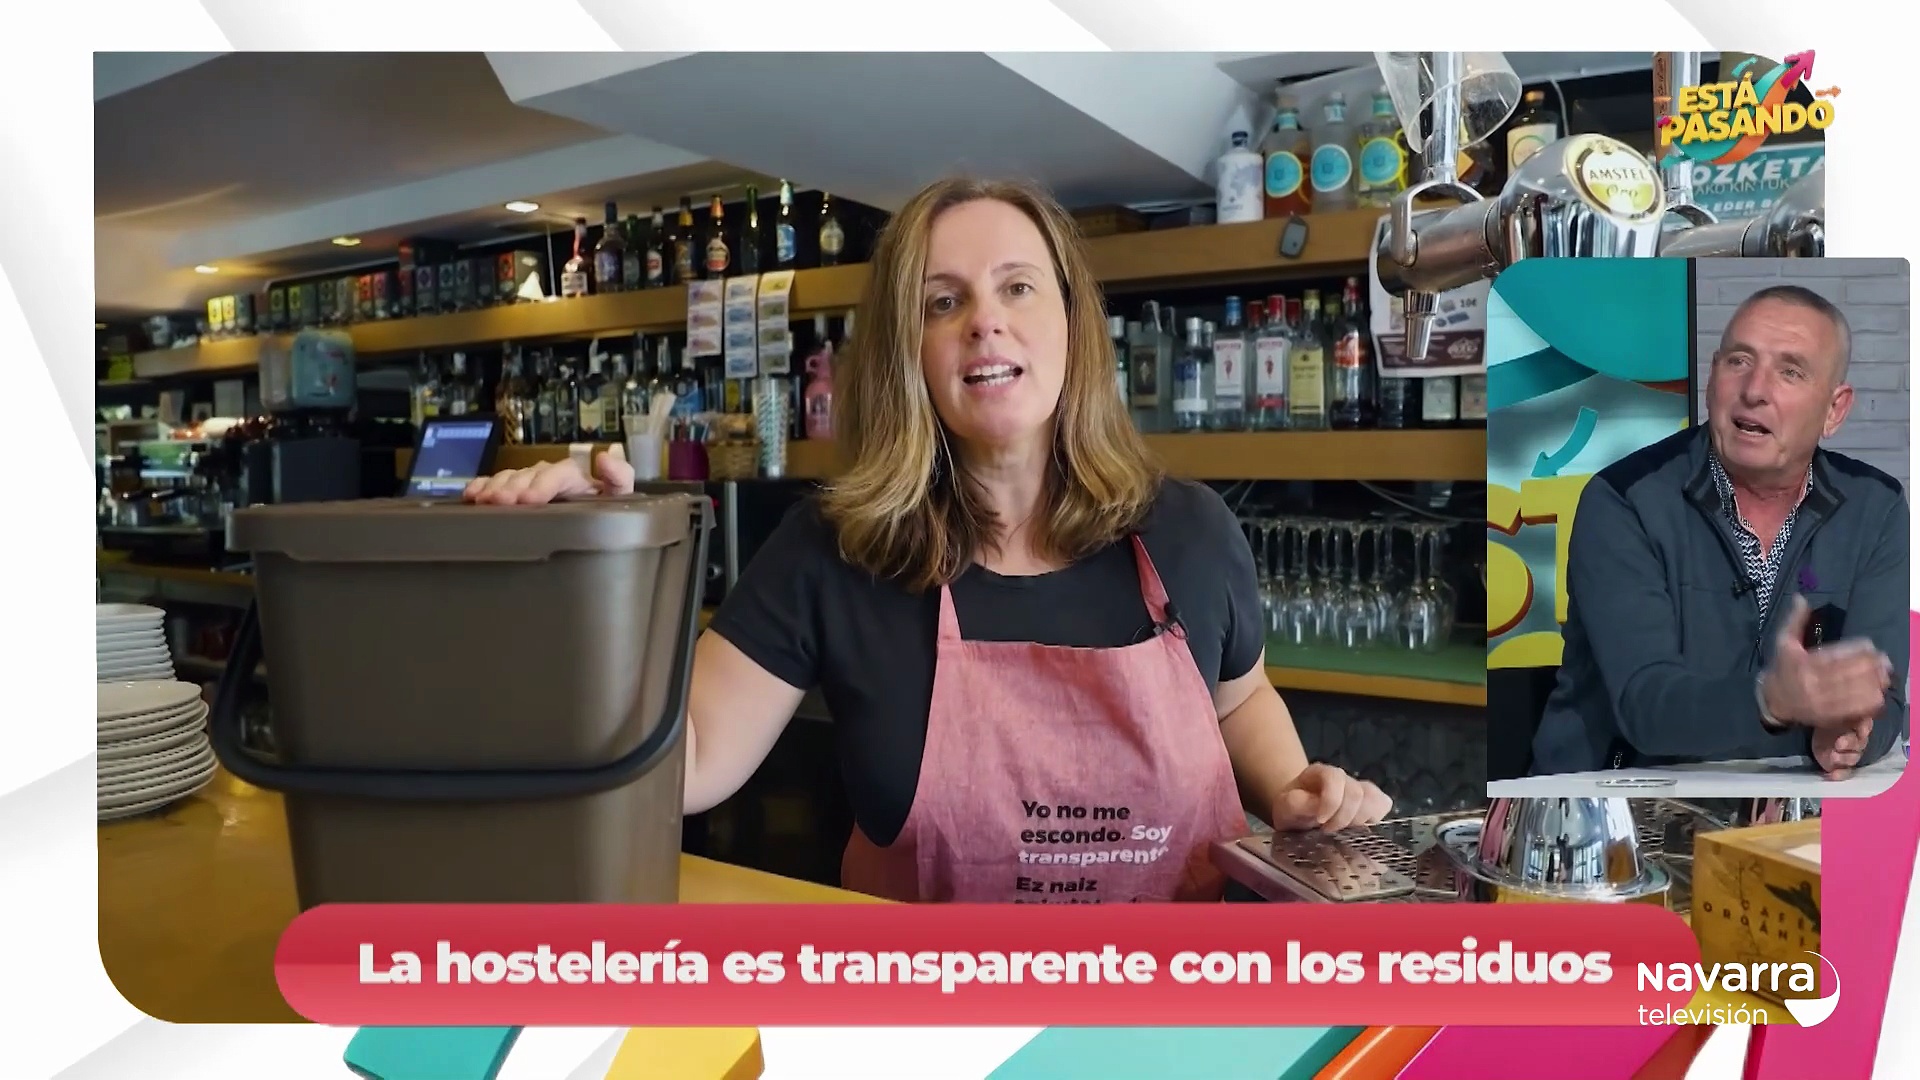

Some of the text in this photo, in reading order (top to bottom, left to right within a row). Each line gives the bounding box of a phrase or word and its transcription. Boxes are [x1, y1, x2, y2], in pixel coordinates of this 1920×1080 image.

[1588, 168, 1645, 180] AMSTEL
[1022, 800, 1131, 820] Yo no me
[1020, 824, 1173, 844] escondo. Soy
[1016, 877, 1098, 893] Ez naiz
